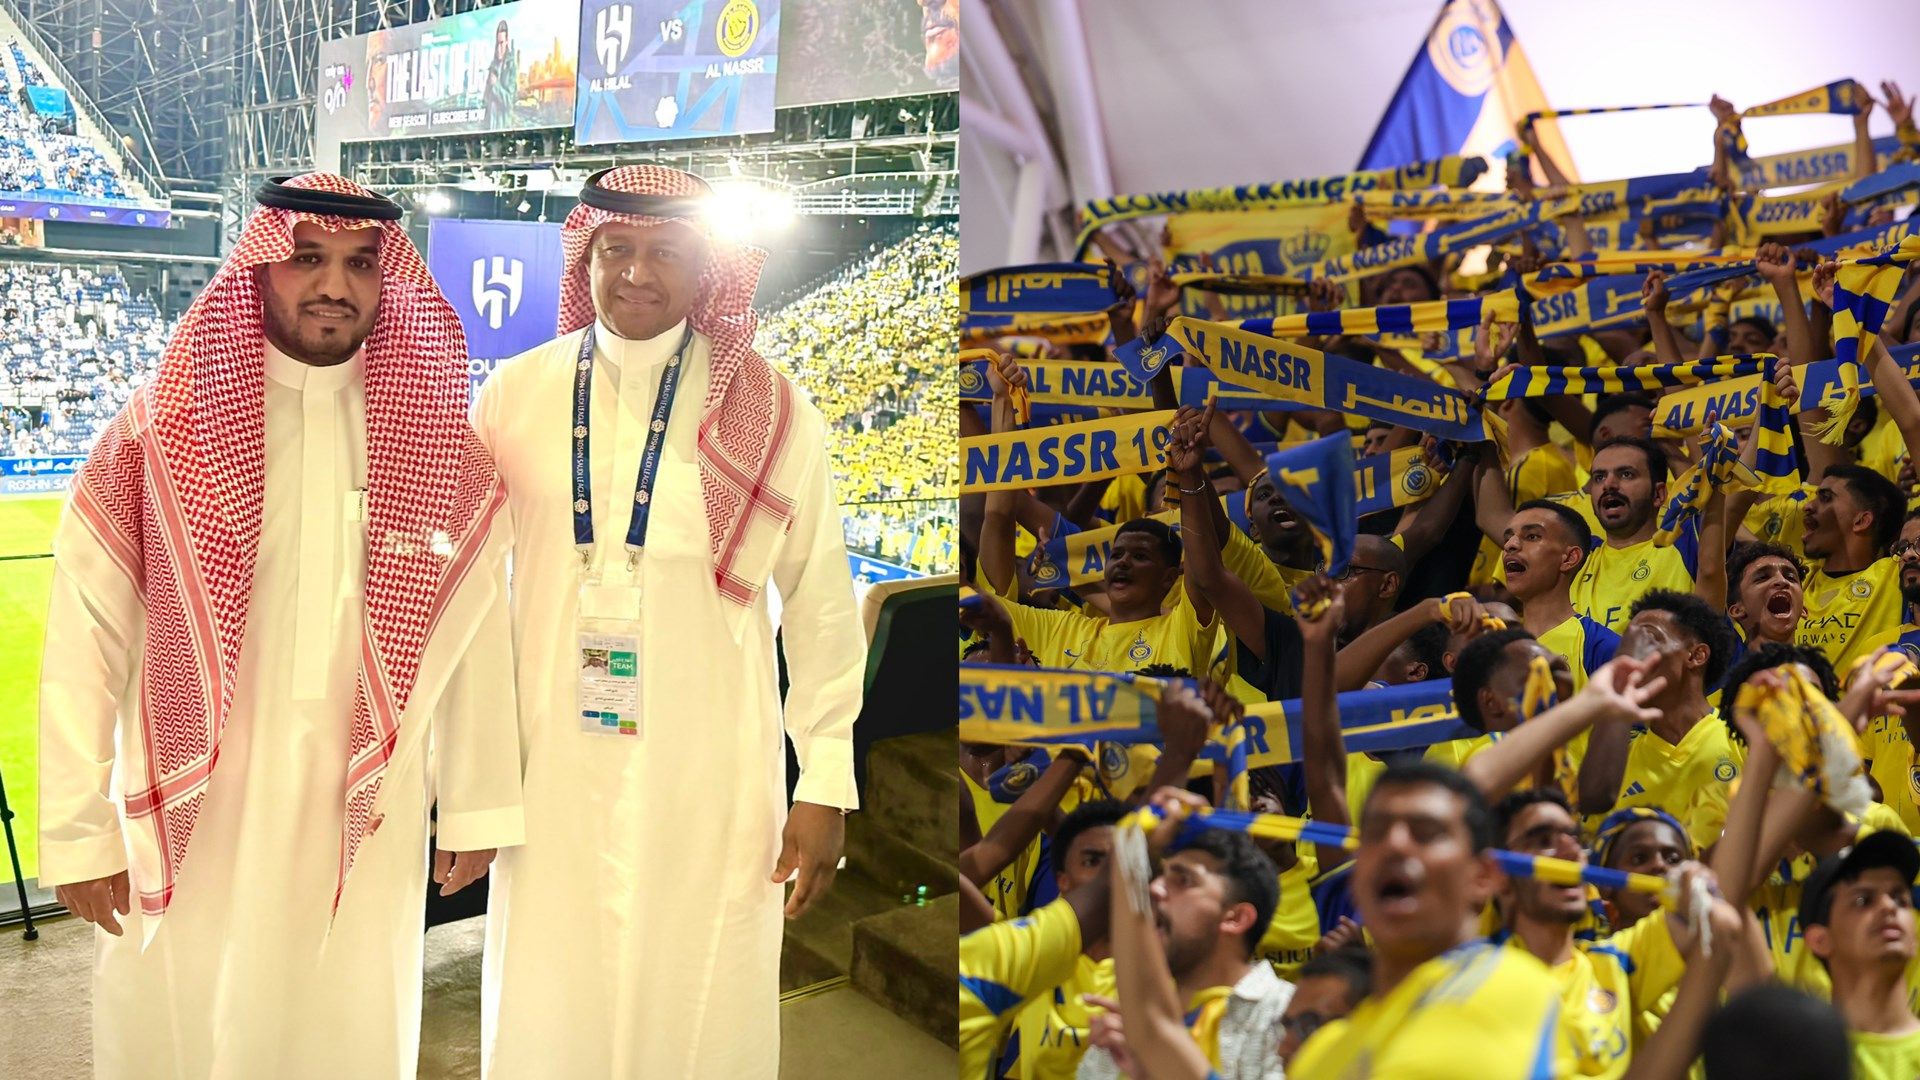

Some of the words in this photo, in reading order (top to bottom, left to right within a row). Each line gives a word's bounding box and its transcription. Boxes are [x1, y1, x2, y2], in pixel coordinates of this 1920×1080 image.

[660, 18, 683, 42] VS
[386, 52, 411, 103] THE
[411, 47, 445, 100] LAST
[705, 64, 721, 79] AL
[723, 57, 764, 77] NASSR
[589, 79, 604, 93] AL
[604, 75, 632, 91] HILAL
[1776, 152, 1848, 181] NASSR
[1083, 191, 1188, 226] LLOW
[1325, 258, 1348, 278] AL
[1531, 291, 1579, 327] SSR
[1220, 336, 1312, 392] NASSR
[1062, 367, 1153, 397] NASS
[1342, 382, 1468, 426] النصر
[1663, 401, 1695, 430] AL
[964, 429, 1120, 486] NASSR
[8, 478, 50, 492] ROSHN
[612, 662, 633, 671] TEAM
[1060, 683, 1118, 724] AL
